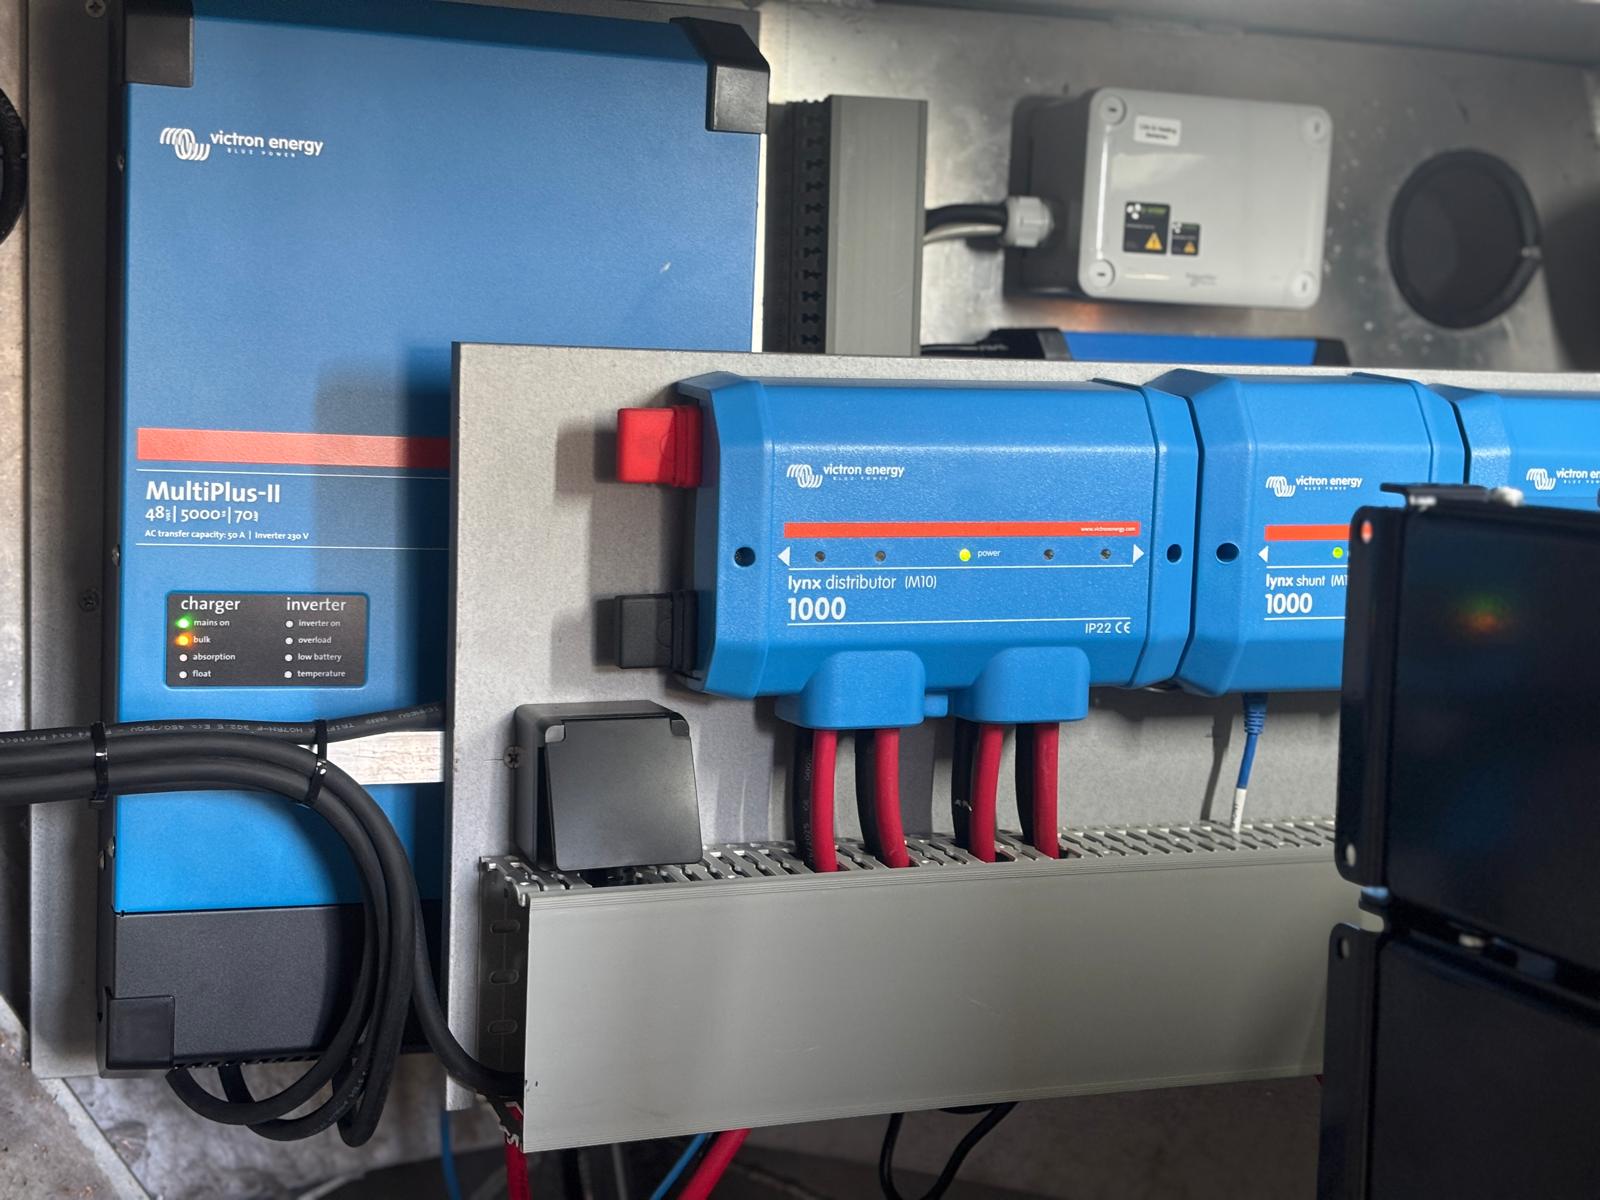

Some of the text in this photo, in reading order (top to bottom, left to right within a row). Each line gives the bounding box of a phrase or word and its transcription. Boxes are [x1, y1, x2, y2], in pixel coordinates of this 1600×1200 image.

[210, 130, 324, 156] victron energy
[261, 150, 296, 158] POWER
[823, 464, 905, 478] victron energy
[1556, 468, 1588, 479] victron
[1296, 475, 1362, 488] victron energy
[146, 480, 281, 503] MultiPlus-II
[181, 509, 220, 522] 5000
[234, 510, 253, 524] 70
[158, 530, 189, 538] transfer
[191, 530, 226, 540] capacity:
[227, 532, 238, 540] 50
[287, 533, 301, 541] 230
[977, 550, 1001, 558] power
[788, 575, 937, 593] lynx distributor (M10)
[1265, 573, 1294, 590] lynx
[1296, 574, 1325, 587] shunt
[180, 596, 241, 614] charger
[286, 597, 347, 611] inverter
[787, 596, 847, 621] 1000
[1265, 592, 1313, 615] 1000
[193, 619, 218, 627] mains
[1085, 623, 1112, 634] IP22
[193, 636, 211, 644] bulk
[298, 636, 332, 644] overload
[192, 653, 236, 662] absorption
[298, 653, 342, 663] low battery
[192, 669, 212, 678] float
[297, 670, 346, 678] temperature
